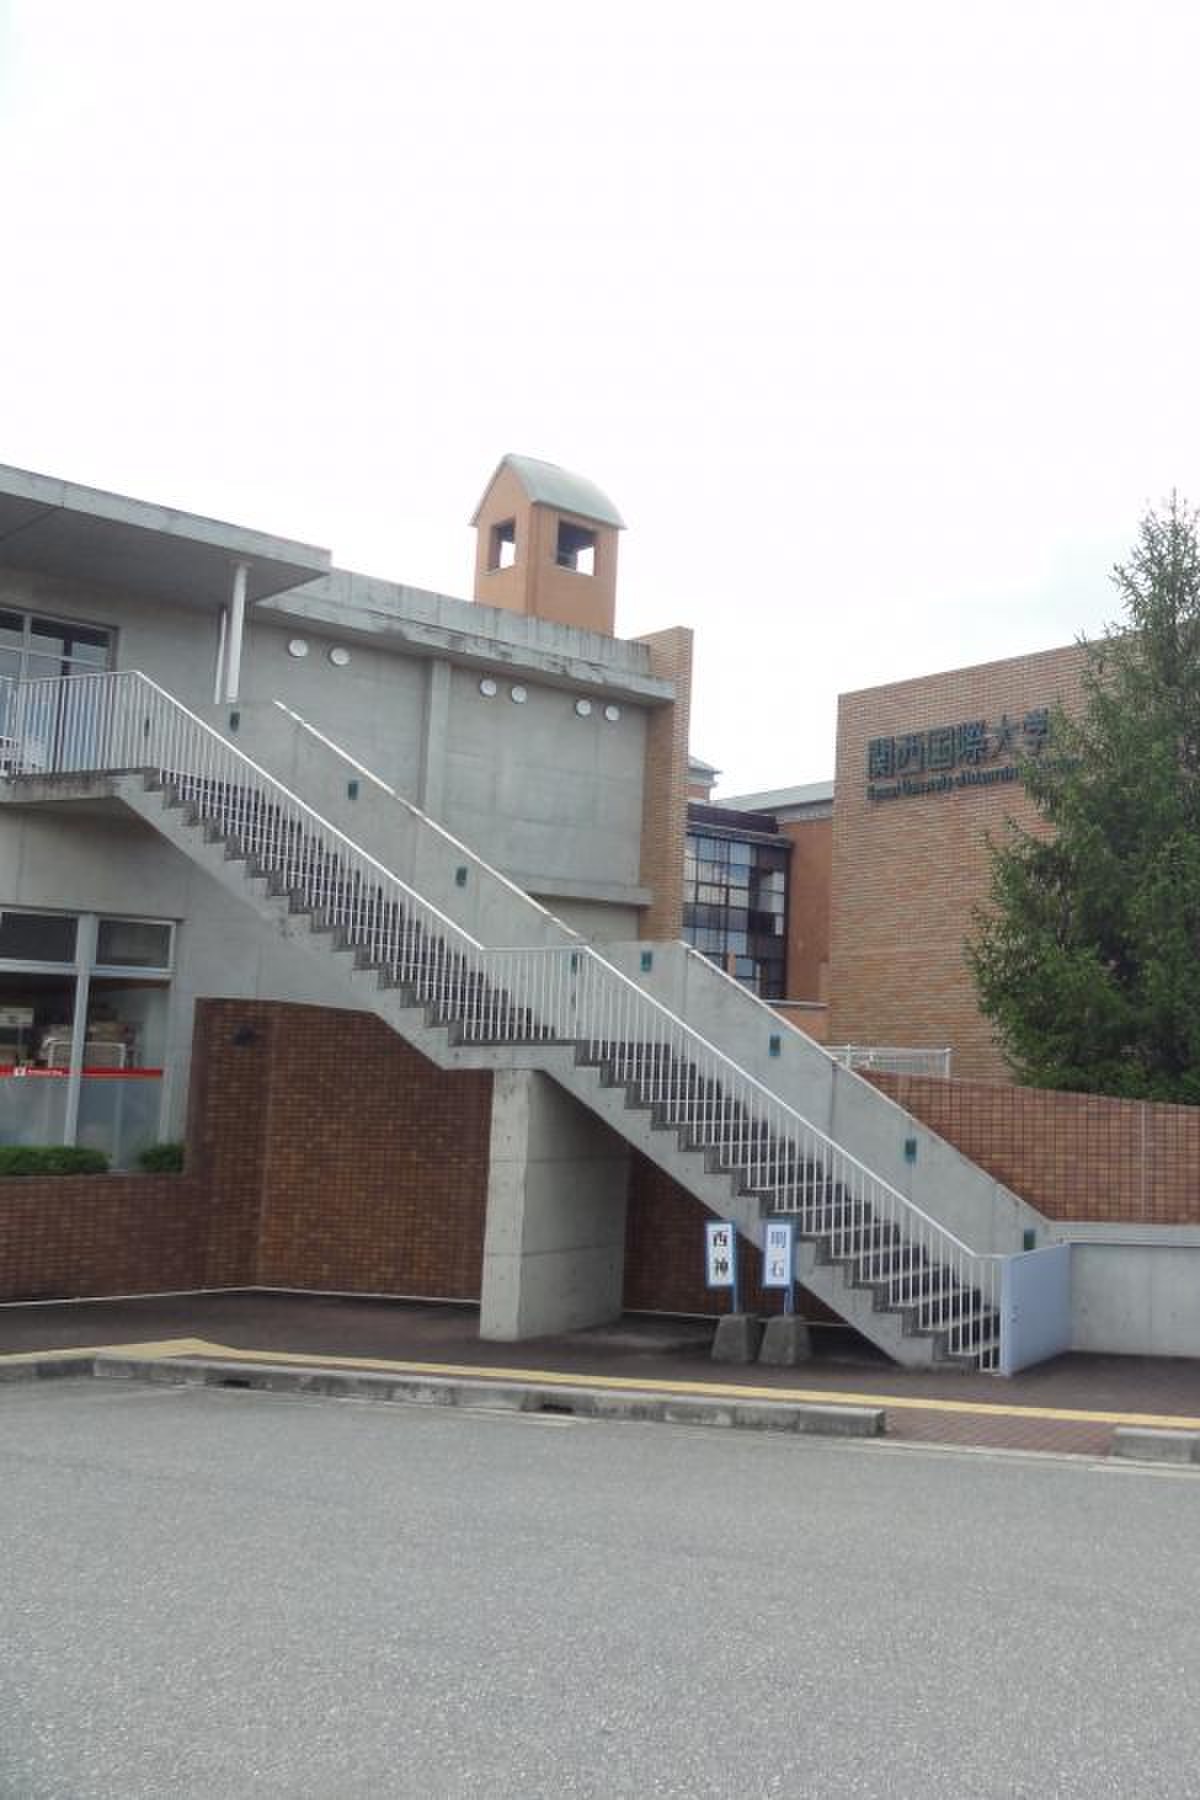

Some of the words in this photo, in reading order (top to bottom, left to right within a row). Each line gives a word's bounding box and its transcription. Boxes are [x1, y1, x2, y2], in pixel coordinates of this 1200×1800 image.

[868, 705, 1053, 779] 関西国際大学
